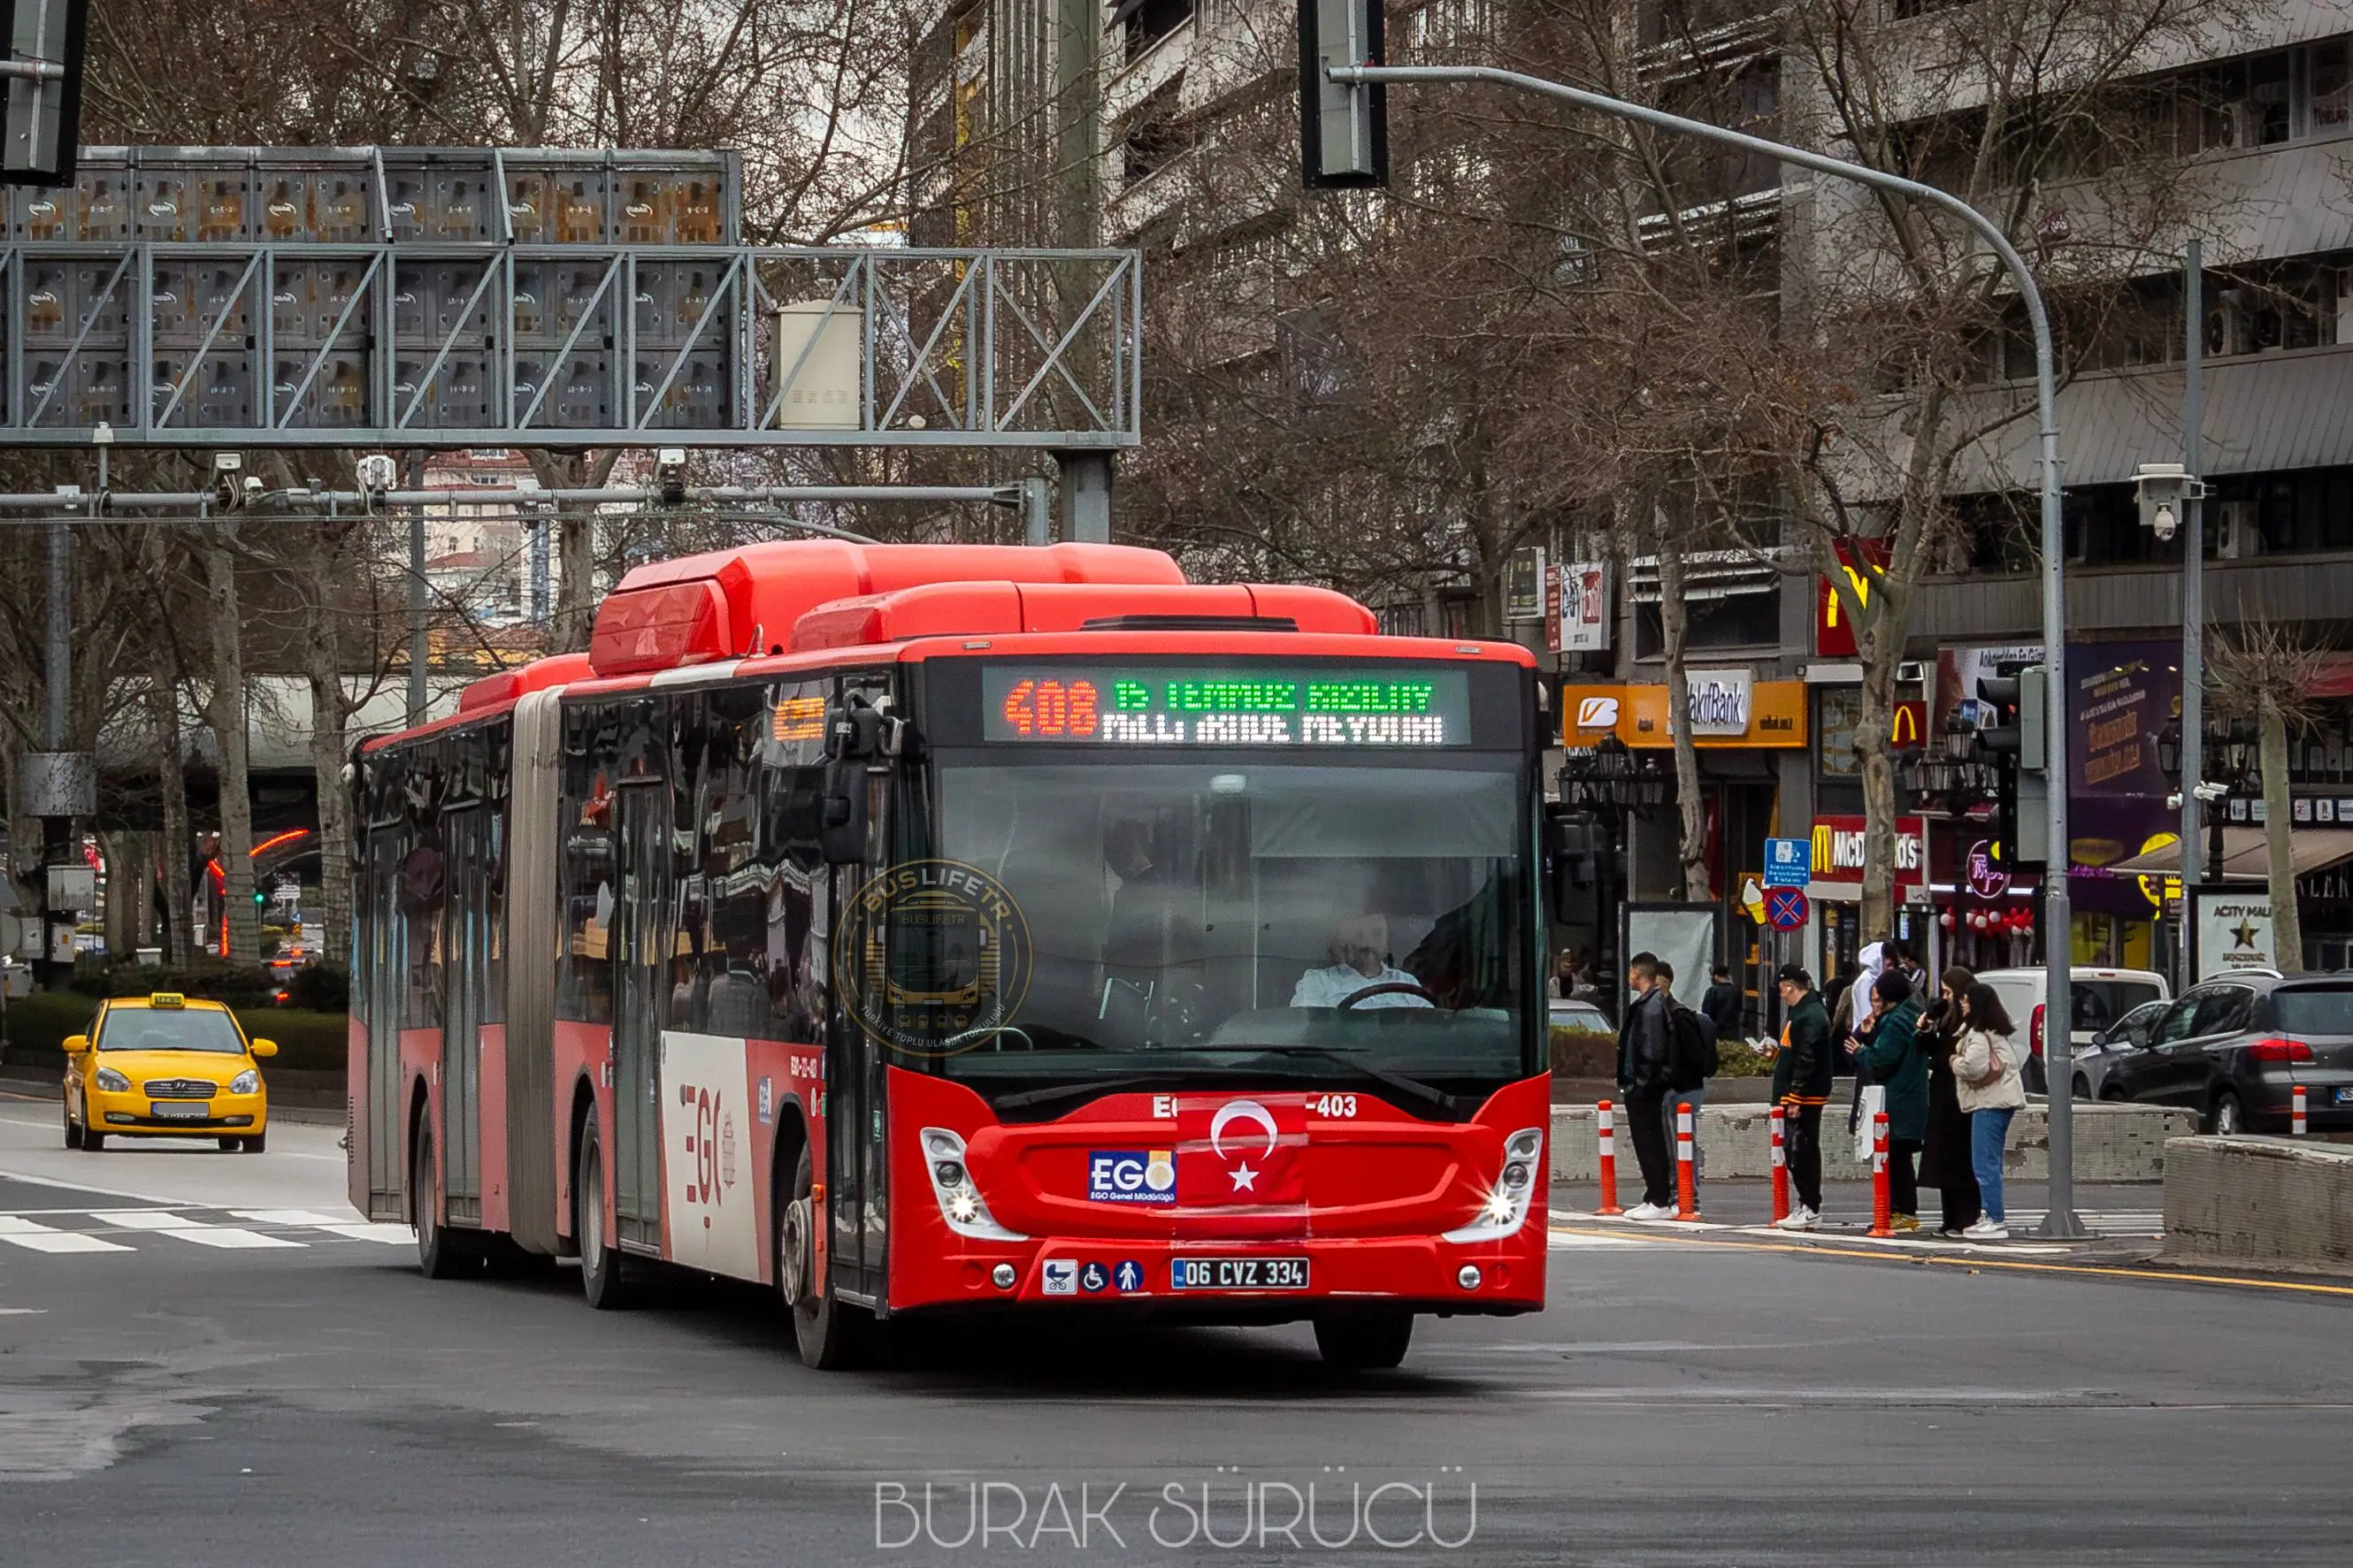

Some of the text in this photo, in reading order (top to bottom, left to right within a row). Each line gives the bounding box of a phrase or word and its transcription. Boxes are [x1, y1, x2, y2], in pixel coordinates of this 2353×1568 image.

[1006, 679, 1098, 735] 408
[1092, 1155, 1176, 1191] EGO
[1185, 1262, 1211, 1285] 06
[1220, 1262, 1257, 1285] CVZ
[1266, 1262, 1303, 1285] 334
